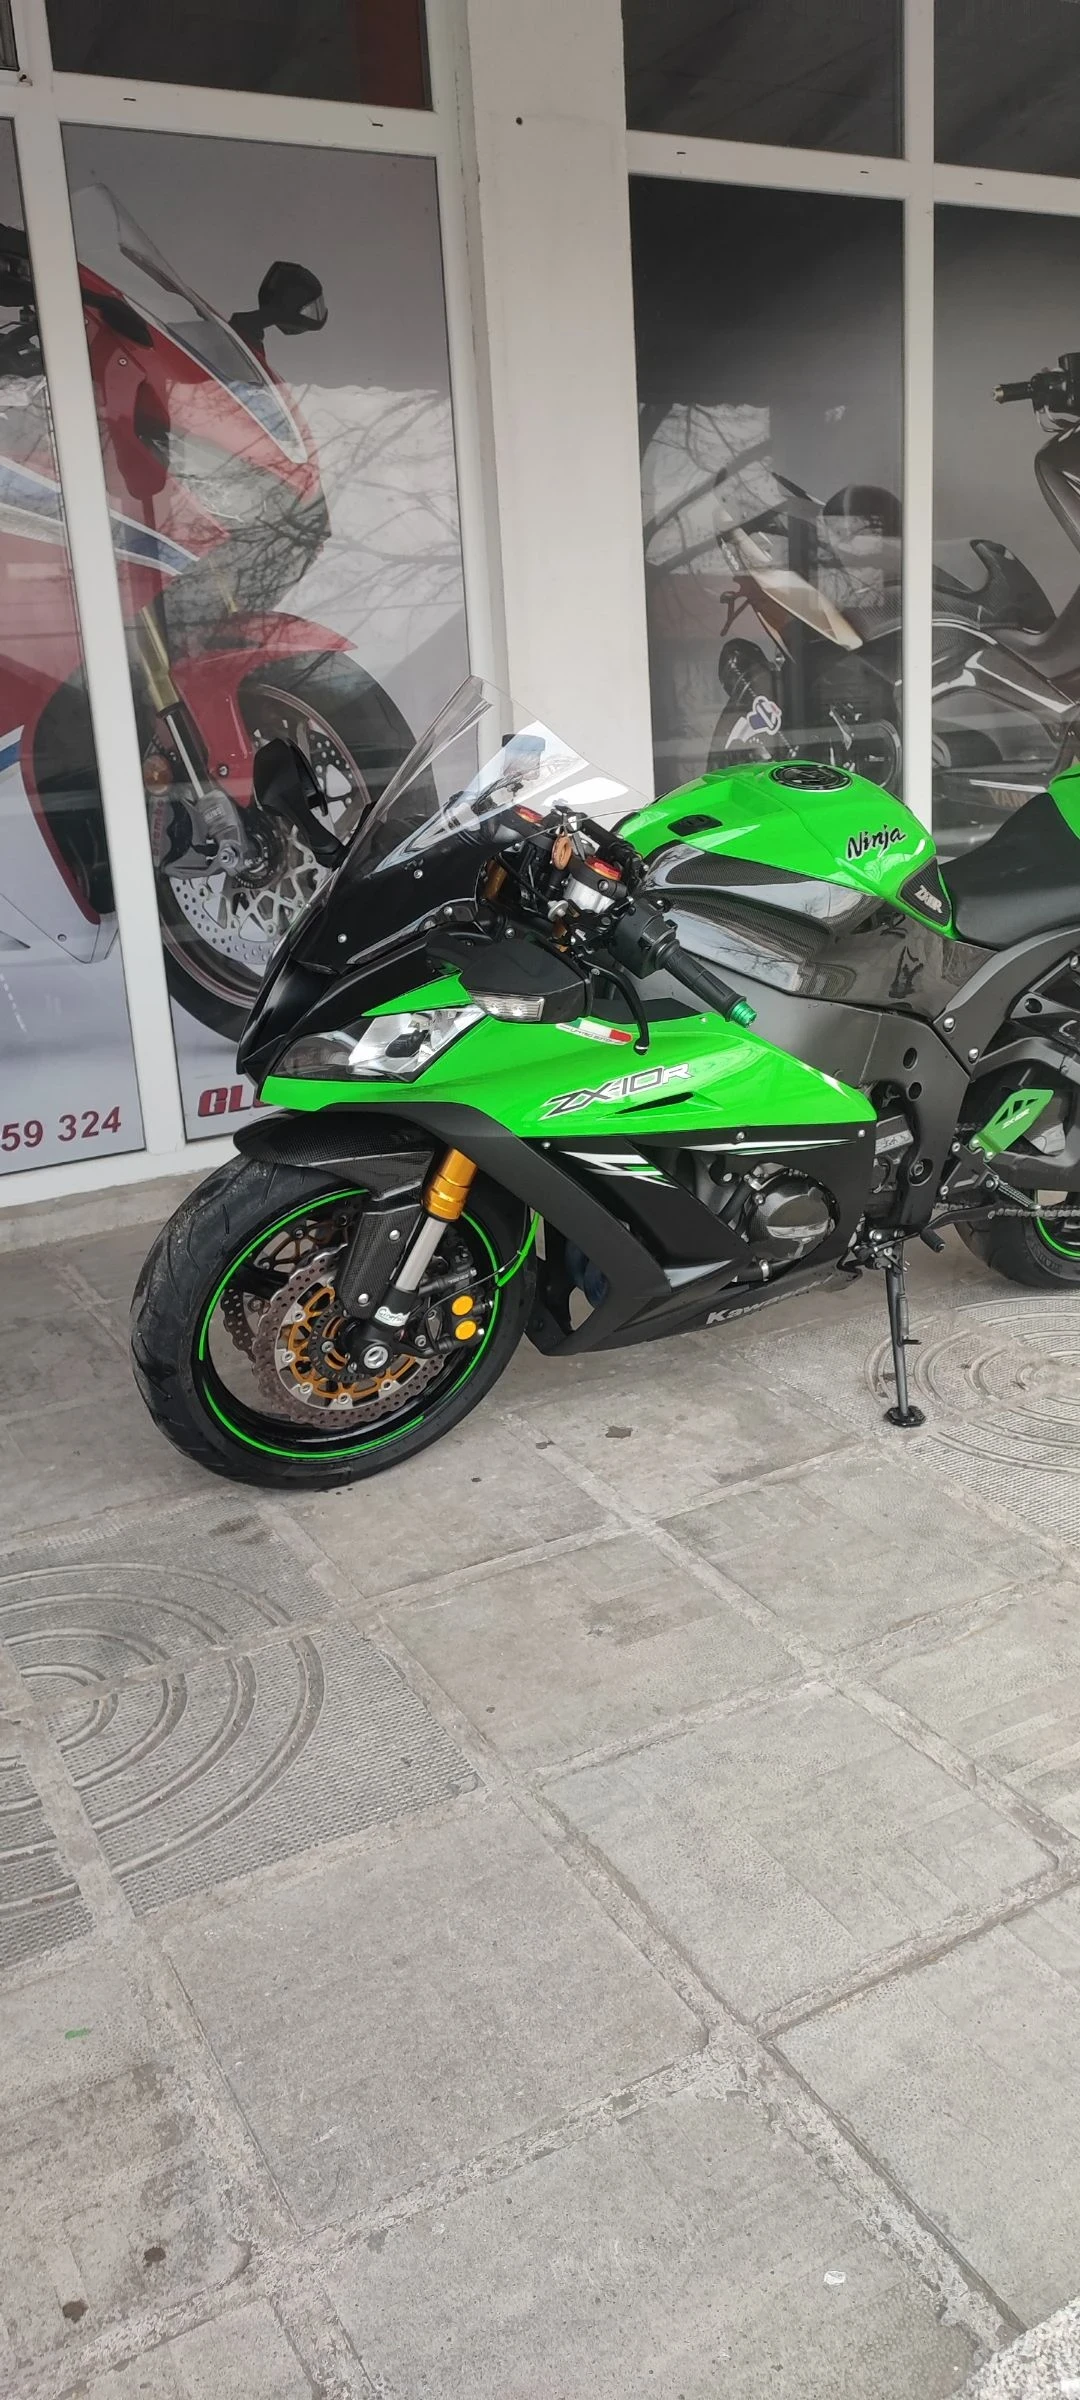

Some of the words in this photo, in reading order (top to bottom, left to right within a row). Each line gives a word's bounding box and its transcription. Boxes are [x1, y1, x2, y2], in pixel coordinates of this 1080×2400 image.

[846, 824, 907, 859] Ninja
[538, 1062, 694, 1121] ZX-10R
[57, 1106, 122, 1142] 324
